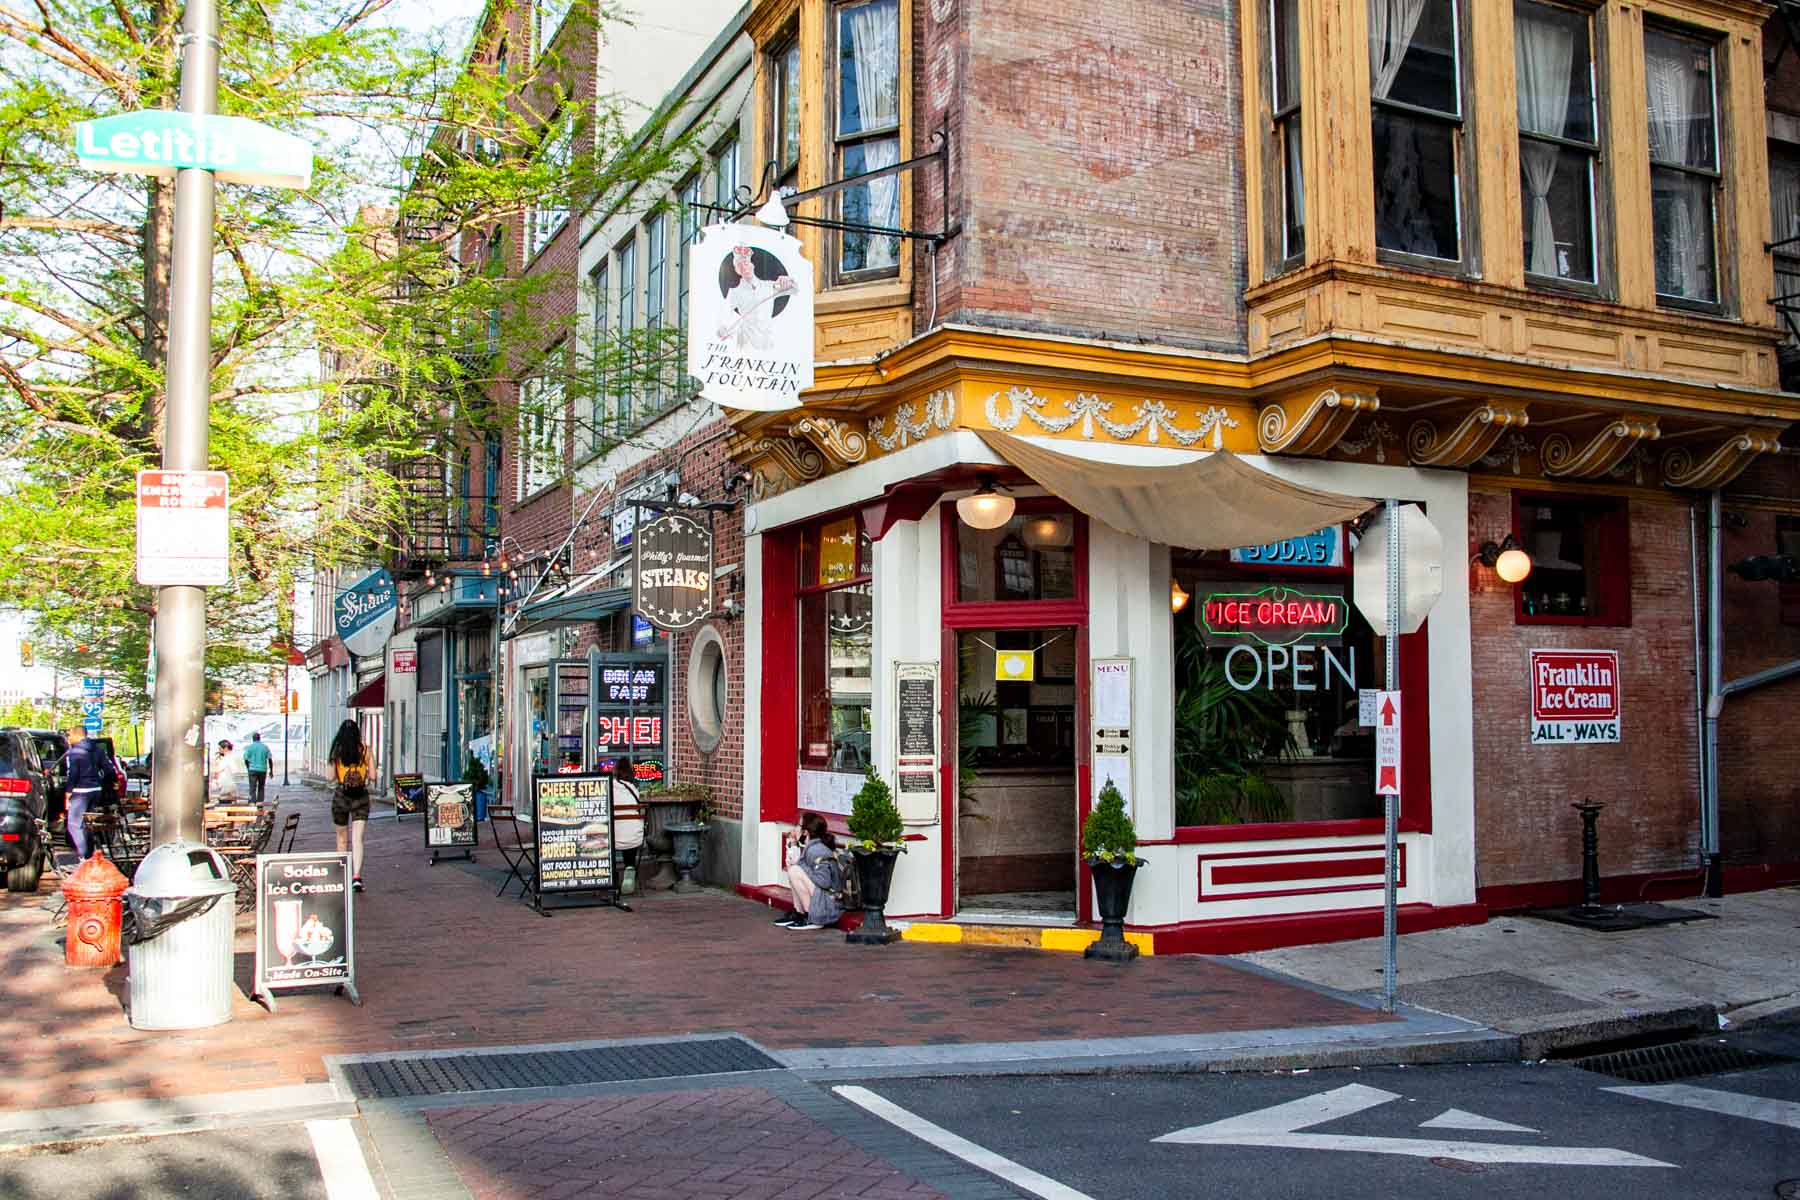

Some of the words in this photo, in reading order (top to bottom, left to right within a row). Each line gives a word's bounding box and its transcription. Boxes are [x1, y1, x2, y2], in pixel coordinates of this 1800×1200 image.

[82, 123, 237, 163] Letitia
[701, 354, 800, 376] FRANKLIN
[706, 372, 800, 393] FOUNTAIN
[641, 552, 673, 565] Philly's
[676, 552, 709, 563] Gourmet
[641, 568, 709, 591] STEAKS
[339, 590, 391, 628] Shane
[1218, 602, 1251, 624] ICE
[1257, 602, 1336, 625] CREAM
[1097, 665, 1128, 673] MENU
[1224, 644, 1356, 692] OPEN
[1538, 663, 1612, 686] Franklin
[1540, 687, 1563, 708] Ice
[1565, 687, 1612, 708] Cream
[85, 702, 102, 714] 95
[540, 782, 576, 797] CHEESE
[578, 781, 607, 796] STEAK
[541, 842, 576, 858] BURGER
[283, 865, 328, 878] Sodas
[542, 862, 554, 870] HOT
[555, 861, 572, 870] FOOD
[578, 860, 597, 869] SALAD
[598, 859, 609, 867] BAR
[542, 870, 574, 880] SANDWICH
[267, 882, 289, 895] Ice
[290, 881, 344, 895] Creams
